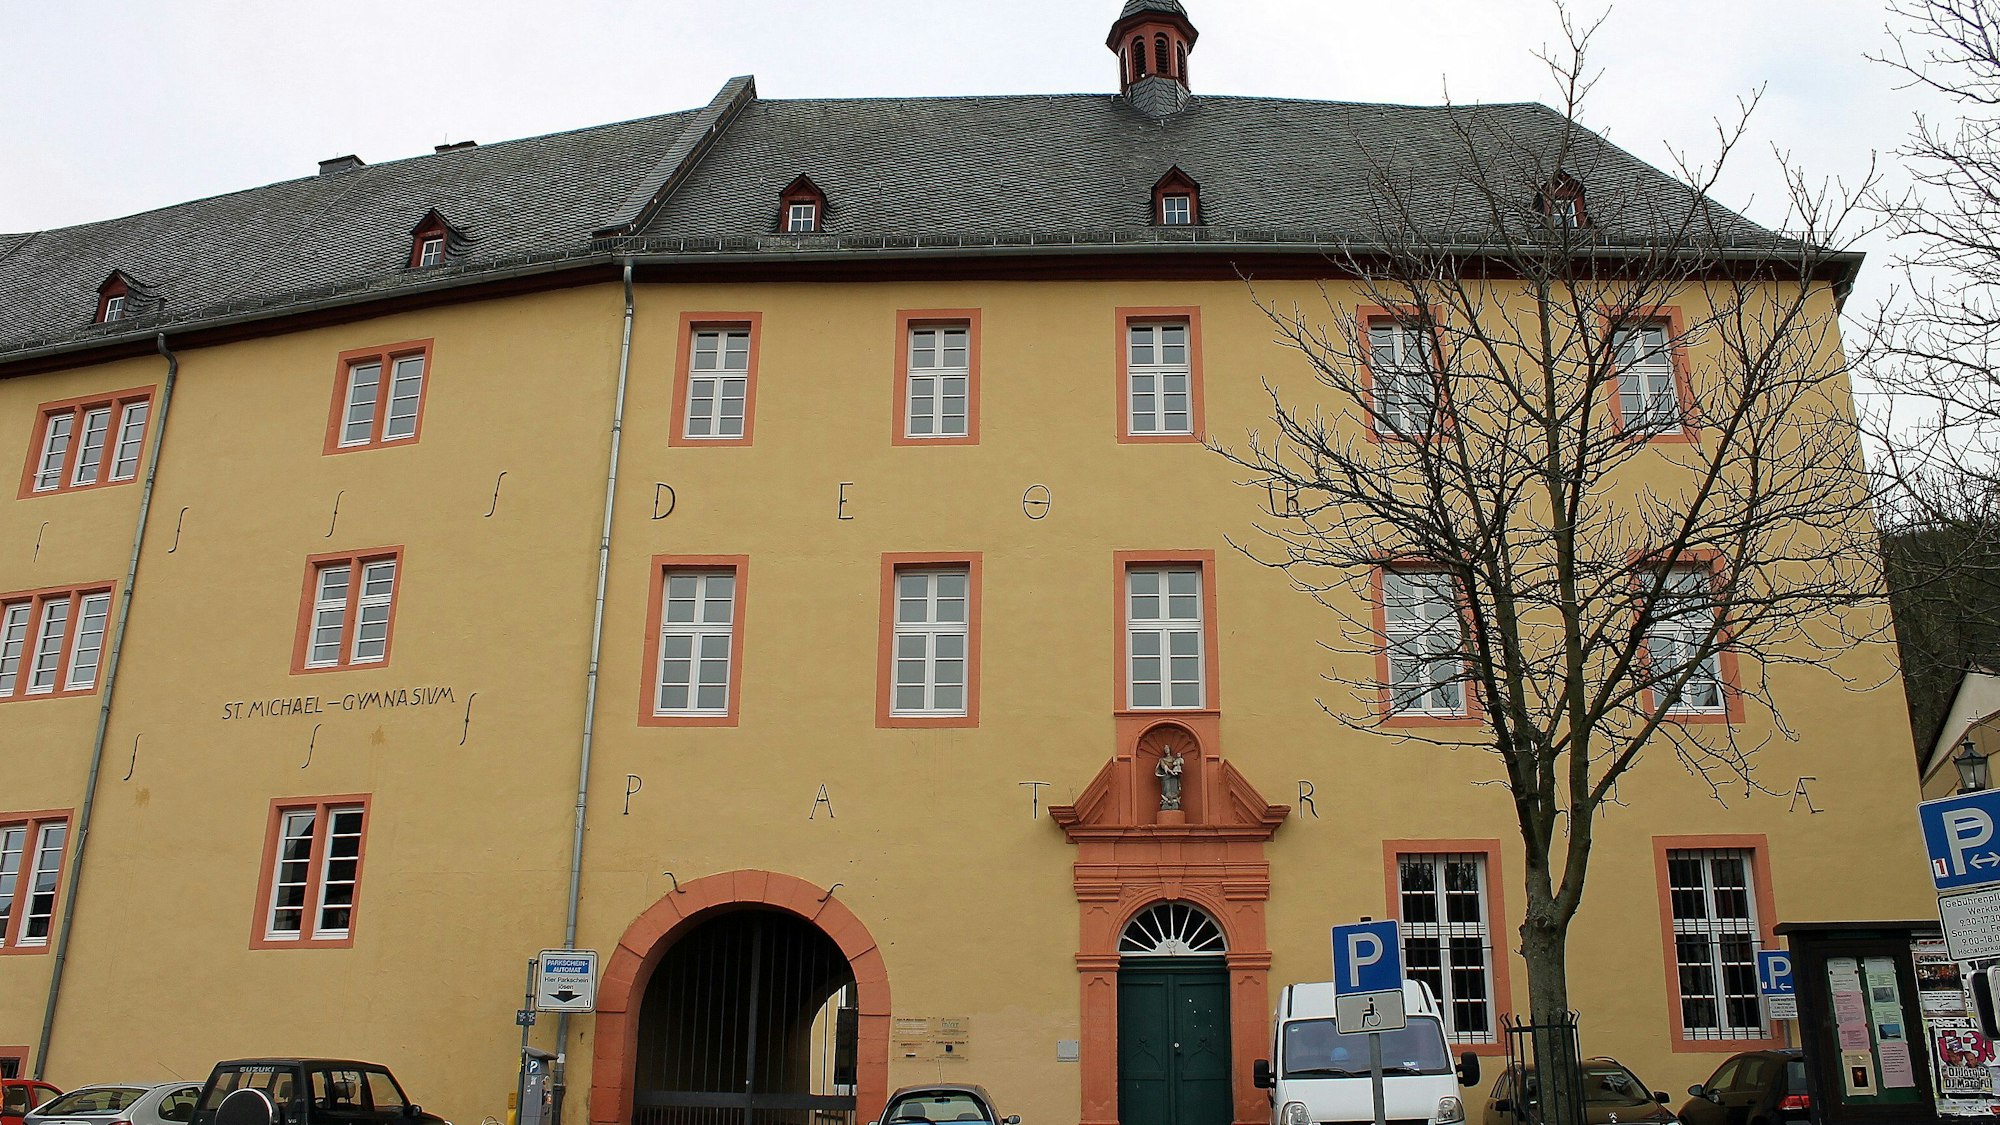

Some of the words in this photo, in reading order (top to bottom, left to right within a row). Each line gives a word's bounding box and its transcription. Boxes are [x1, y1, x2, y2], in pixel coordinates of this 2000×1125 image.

[1942, 807, 1994, 877] P
[1347, 932, 1383, 987] P
[1767, 956, 1791, 989] P
[529, 1060, 539, 1073] P
